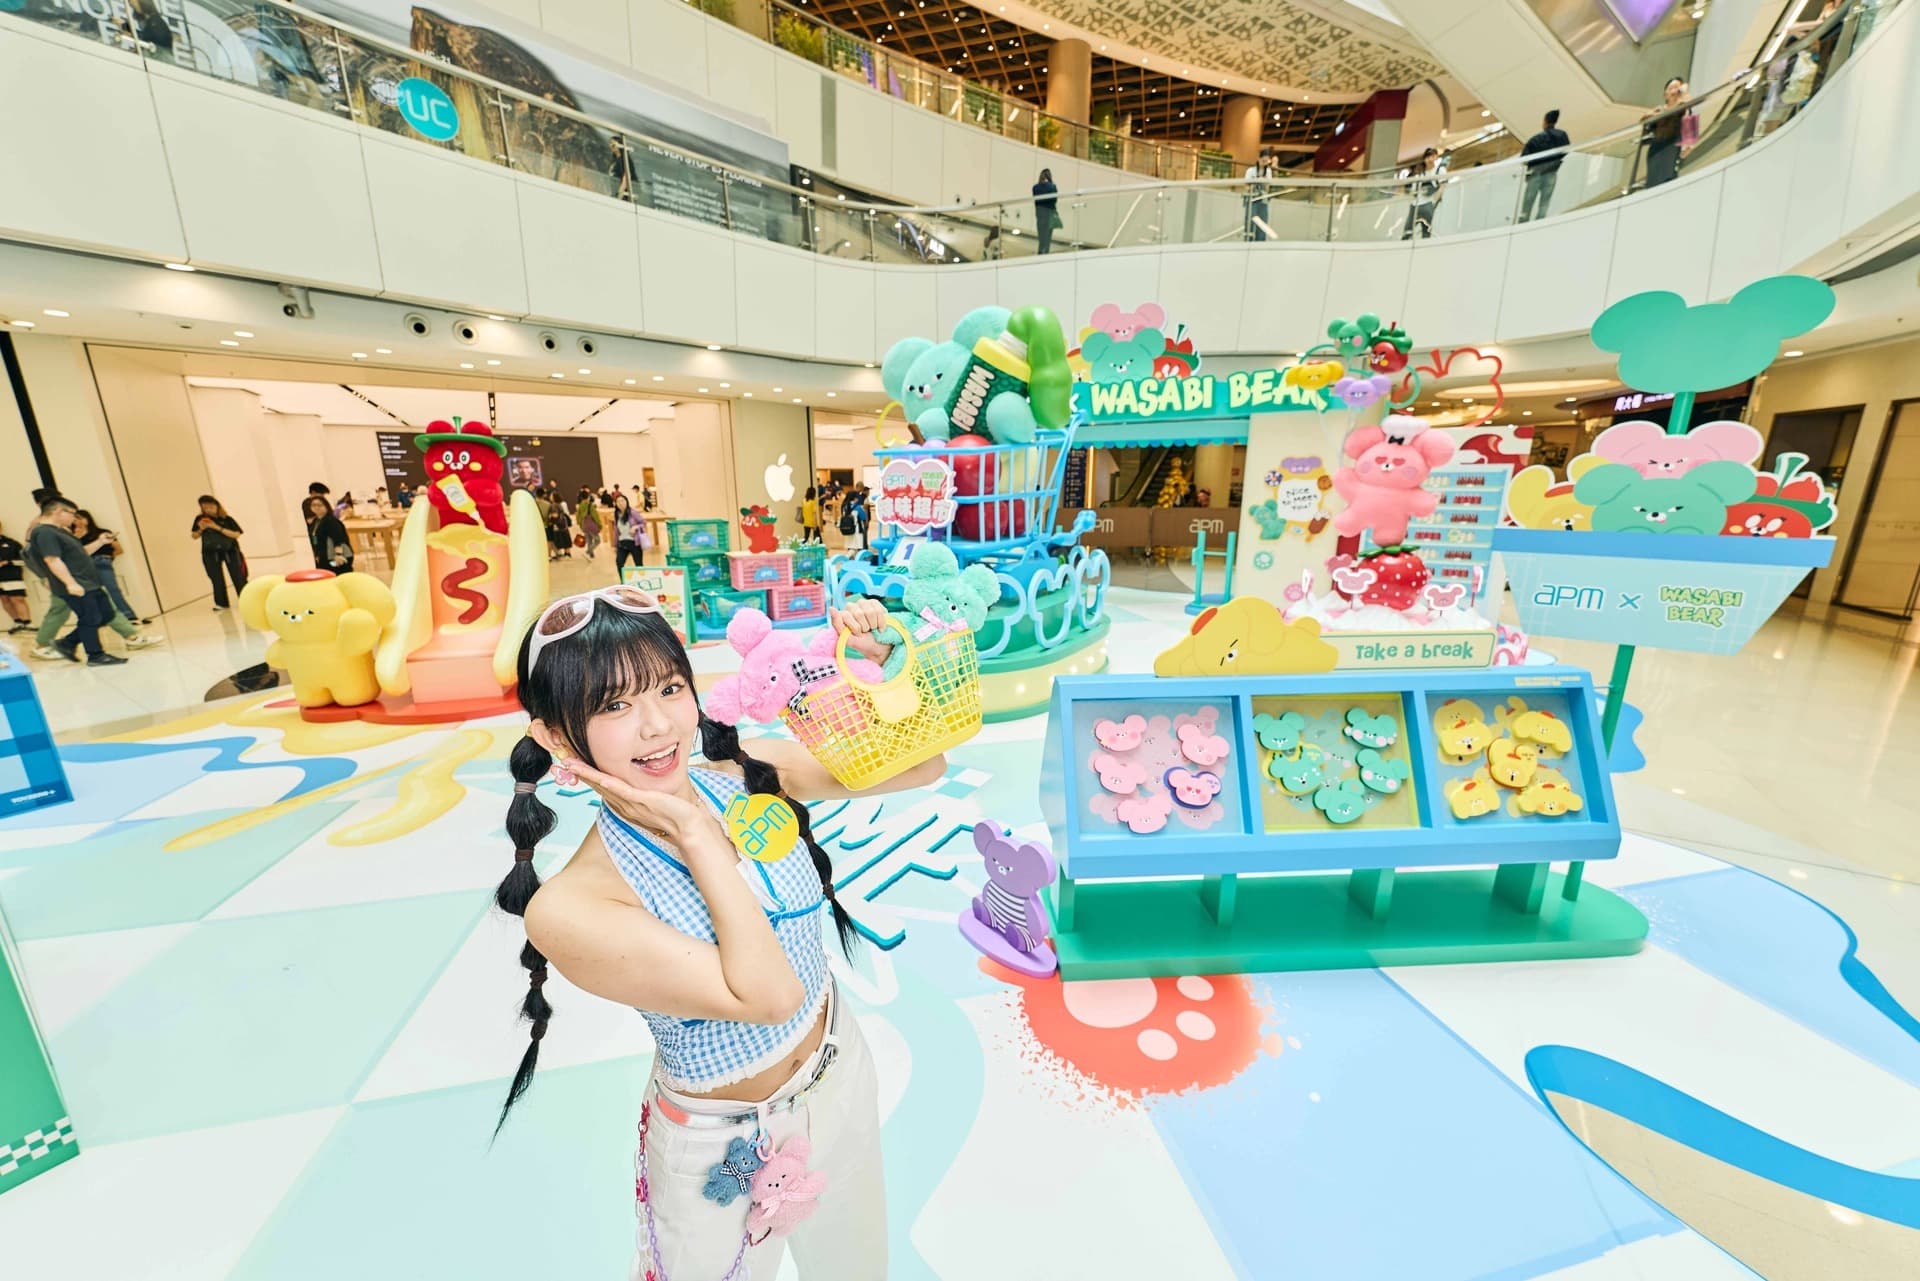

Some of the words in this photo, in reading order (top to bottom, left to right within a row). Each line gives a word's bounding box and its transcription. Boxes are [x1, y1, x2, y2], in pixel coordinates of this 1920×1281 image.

[405, 88, 452, 129] UC
[950, 364, 995, 432] WASABI
[1091, 376, 1213, 416] WASABI
[904, 544, 915, 560] 1
[1660, 586, 1743, 607] WASABI
[1667, 606, 1725, 627] BEAR
[1356, 642, 1398, 661] Take
[1404, 644, 1415, 658] a
[1421, 641, 1474, 660] break
